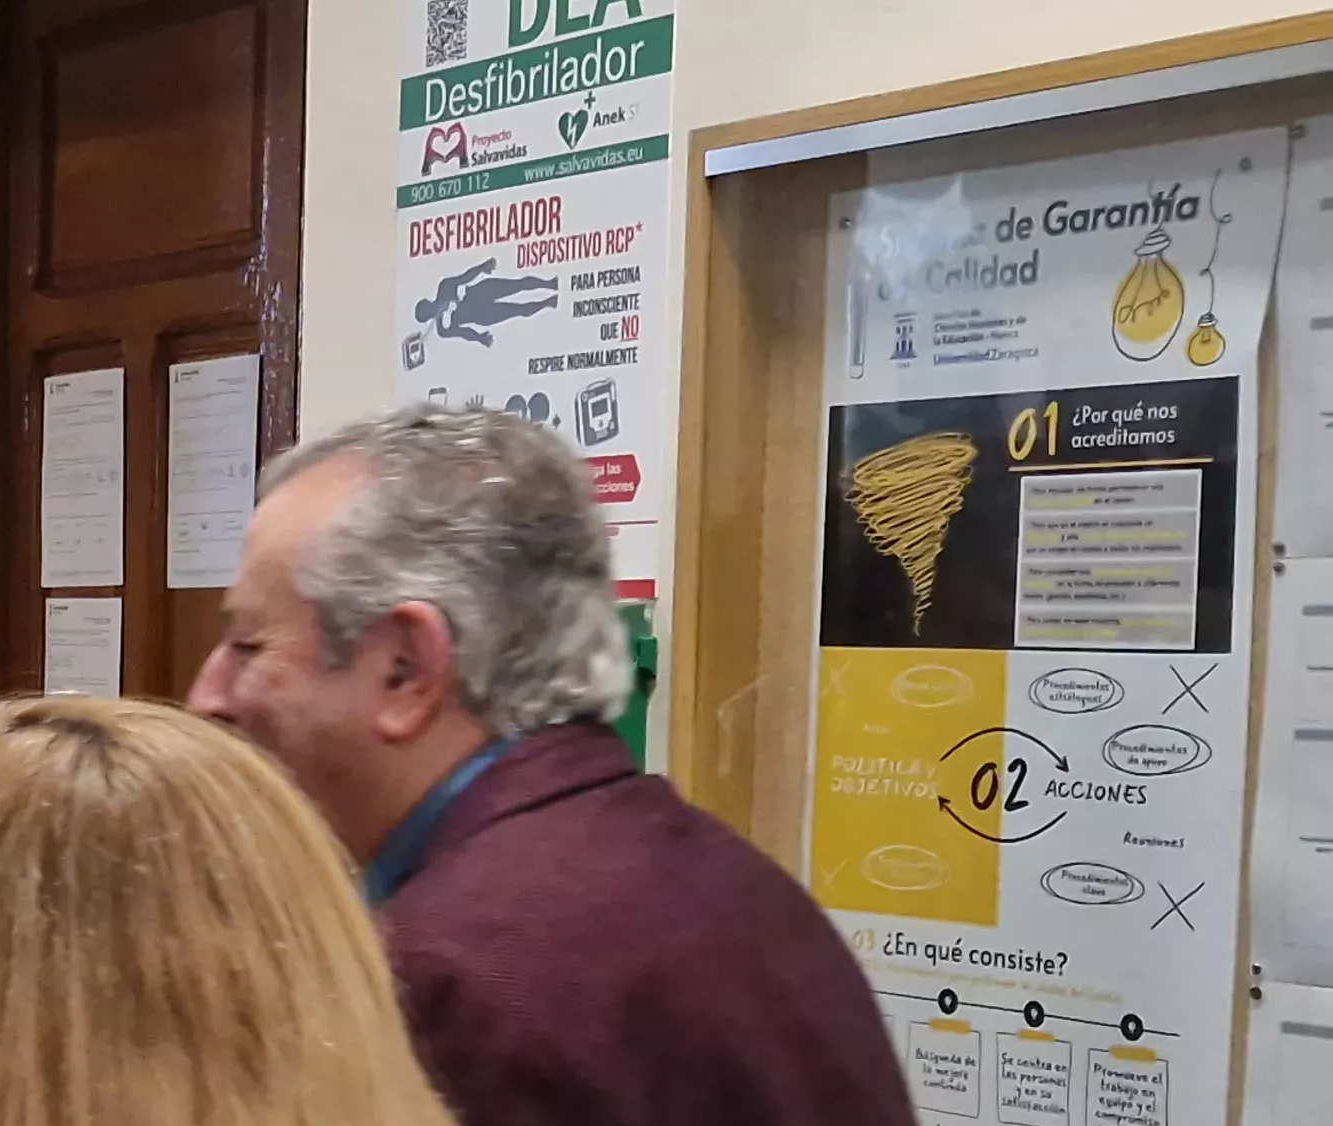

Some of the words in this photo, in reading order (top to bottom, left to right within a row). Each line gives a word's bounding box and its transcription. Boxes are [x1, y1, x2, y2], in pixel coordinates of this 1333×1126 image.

[425, 37, 645, 122] Desfibrilador
[593, 106, 626, 128] Anek
[471, 129, 512, 148] Proyecto
[471, 144, 528, 167] Salvavidas
[411, 183, 433, 203] 900
[438, 178, 461, 198] 670
[468, 172, 490, 192] 112
[524, 145, 643, 182] www.salvavidas.eu
[995, 206, 1033, 243] de
[1043, 183, 1199, 236] Garantía
[409, 196, 561, 257] DESFIBRILADOR
[517, 230, 601, 268] DISPOSITIVO
[571, 272, 595, 291] PARA
[597, 266, 640, 287] PERSONA
[926, 249, 1039, 288] Calidad
[573, 293, 640, 318] INCONSCIENTE
[600, 322, 618, 341] QUE
[621, 315, 639, 340] NO
[528, 355, 565, 375] RESPIRE
[566, 347, 638, 370] NORMALMENTE
[1073, 405, 1107, 427] ¿Por
[1112, 400, 1142, 425] qué
[1147, 405, 1177, 420] nos
[1008, 401, 1059, 460] 01
[1071, 427, 1175, 448] acreditamos
[832, 777, 938, 800] OBJETIVOS
[970, 758, 1029, 812] 02
[1044, 780, 1147, 805] ACCIONES
[883, 932, 917, 956] ¿En
[924, 937, 963, 966] qué
[969, 948, 1069, 976] consiste?
[1001, 1052, 1013, 1065] Se
[1017, 1057, 1052, 1071] centra
[1054, 1064, 1068, 1072] en
[1094, 1063, 1148, 1082] Promueve
[1151, 1072, 1162, 1084] el
[1001, 1066, 1017, 1080] las
[1020, 1073, 1067, 1088] personas
[1100, 1079, 1138, 1100] trabajo
[1141, 1089, 1156, 1098] en
[1016, 1086, 1022, 1099] y
[1024, 1087, 1037, 1096] en
[1040, 1090, 1052, 1099] su
[1094, 1111, 1160, 1126] compromiso
[1099, 1097, 1133, 1112] equipo
[1136, 1103, 1142, 1116] y
[1145, 1098, 1156, 1112] el
